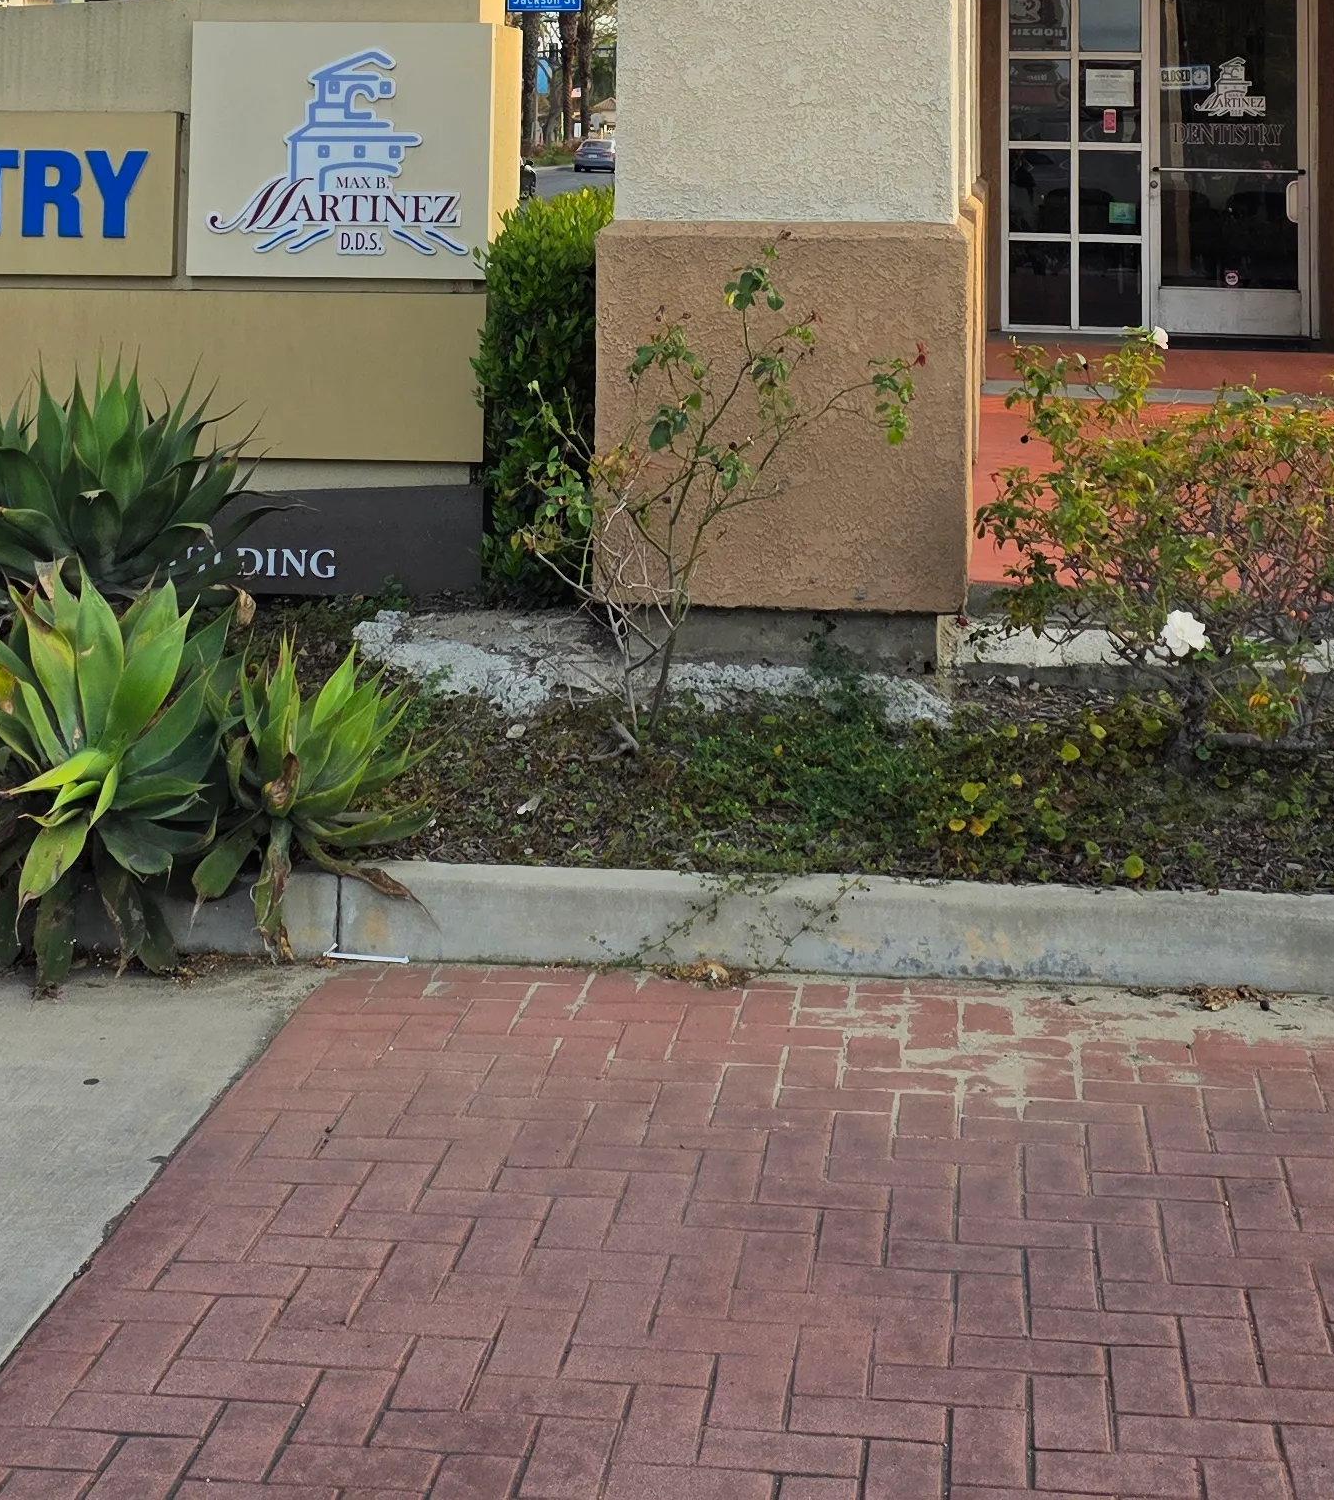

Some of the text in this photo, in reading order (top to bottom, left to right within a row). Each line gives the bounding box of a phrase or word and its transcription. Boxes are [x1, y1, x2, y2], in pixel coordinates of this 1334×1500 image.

[1194, 94, 1265, 111] MARTINEZ
[1170, 122, 1285, 145] DENTISTRY
[336, 176, 390, 189] MAX B.
[210, 176, 461, 230] MARTINEZ
[340, 232, 382, 251] D.D.S.
